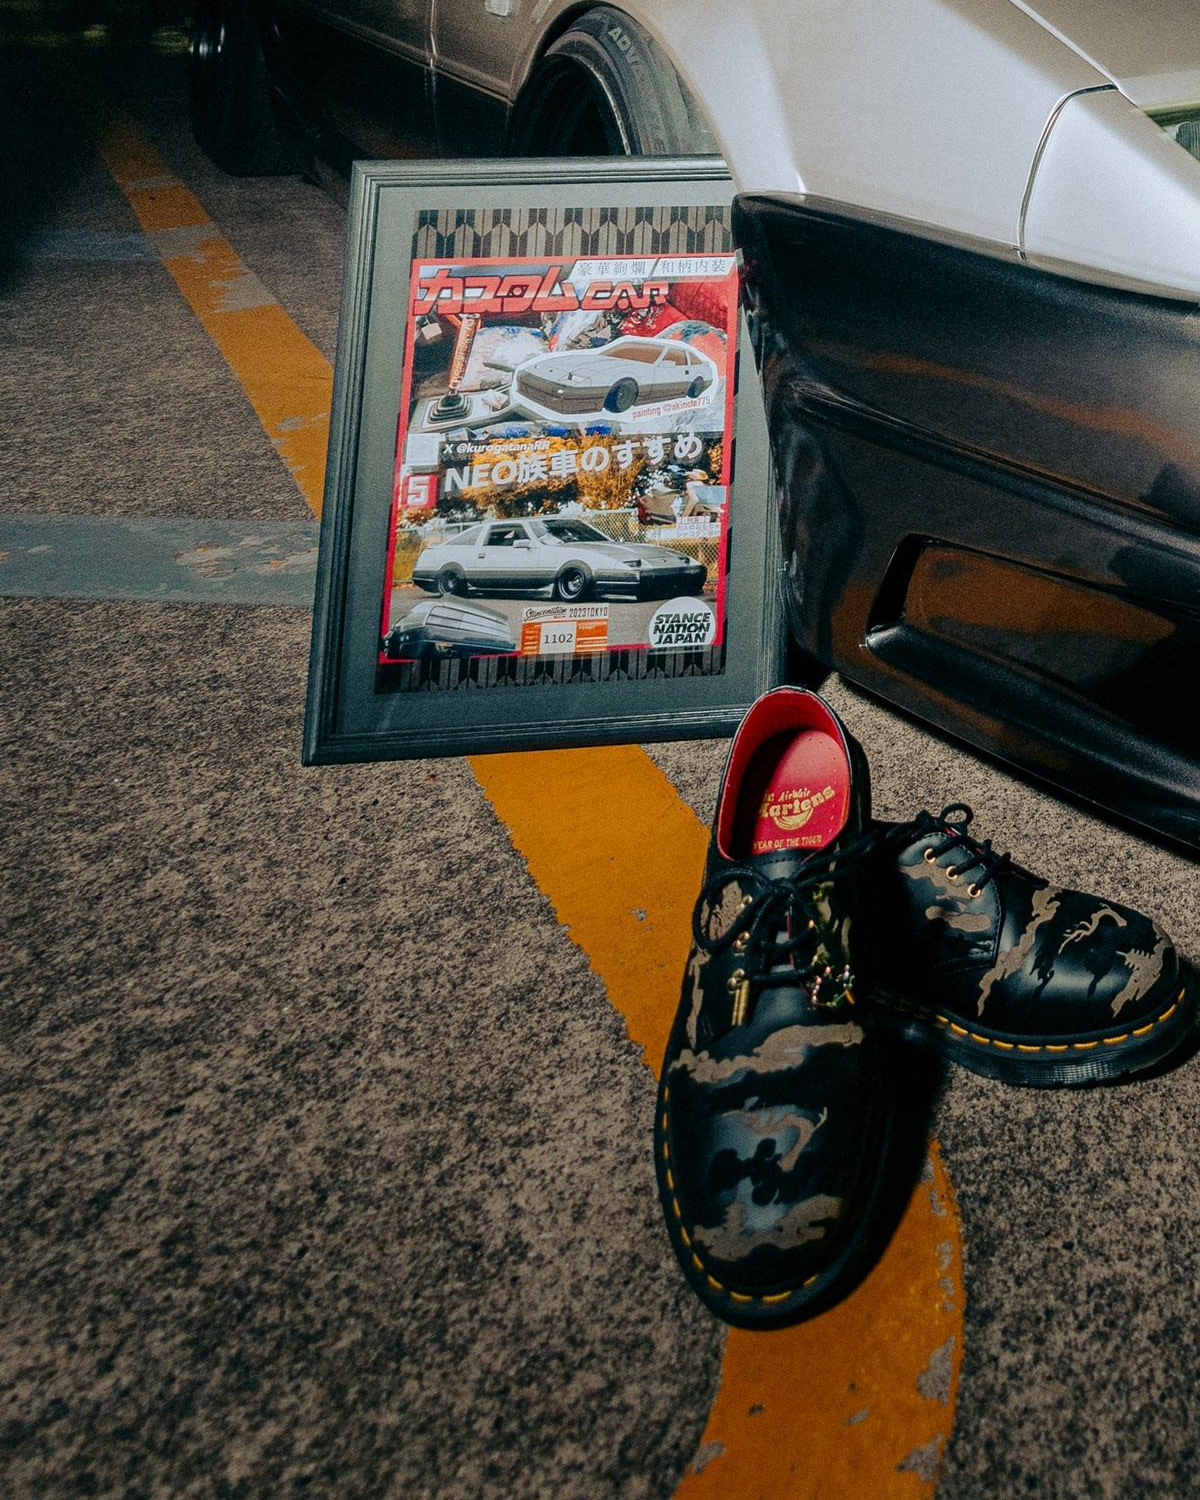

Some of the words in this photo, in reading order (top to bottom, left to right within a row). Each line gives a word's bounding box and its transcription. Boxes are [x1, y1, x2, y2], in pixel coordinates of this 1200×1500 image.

[577, 261, 647, 277] 豪華絢爛
[660, 258, 727, 273] 和柄内装
[632, 406, 661, 420] painting
[662, 396, 711, 412] @akinote775
[443, 443, 453, 454] X
[456, 440, 550, 455] @kurogatanaRR
[444, 433, 703, 493] NEO族車のすすめ
[407, 475, 429, 506] 5
[655, 612, 711, 625] STANCE
[653, 623, 711, 634] NATION
[543, 633, 573, 644] 1102
[654, 633, 706, 645] JAPAN
[753, 840, 773, 850] YEAR
[774, 839, 784, 848] OF
[786, 837, 800, 847] THE
[801, 835, 822, 844] TIGER
